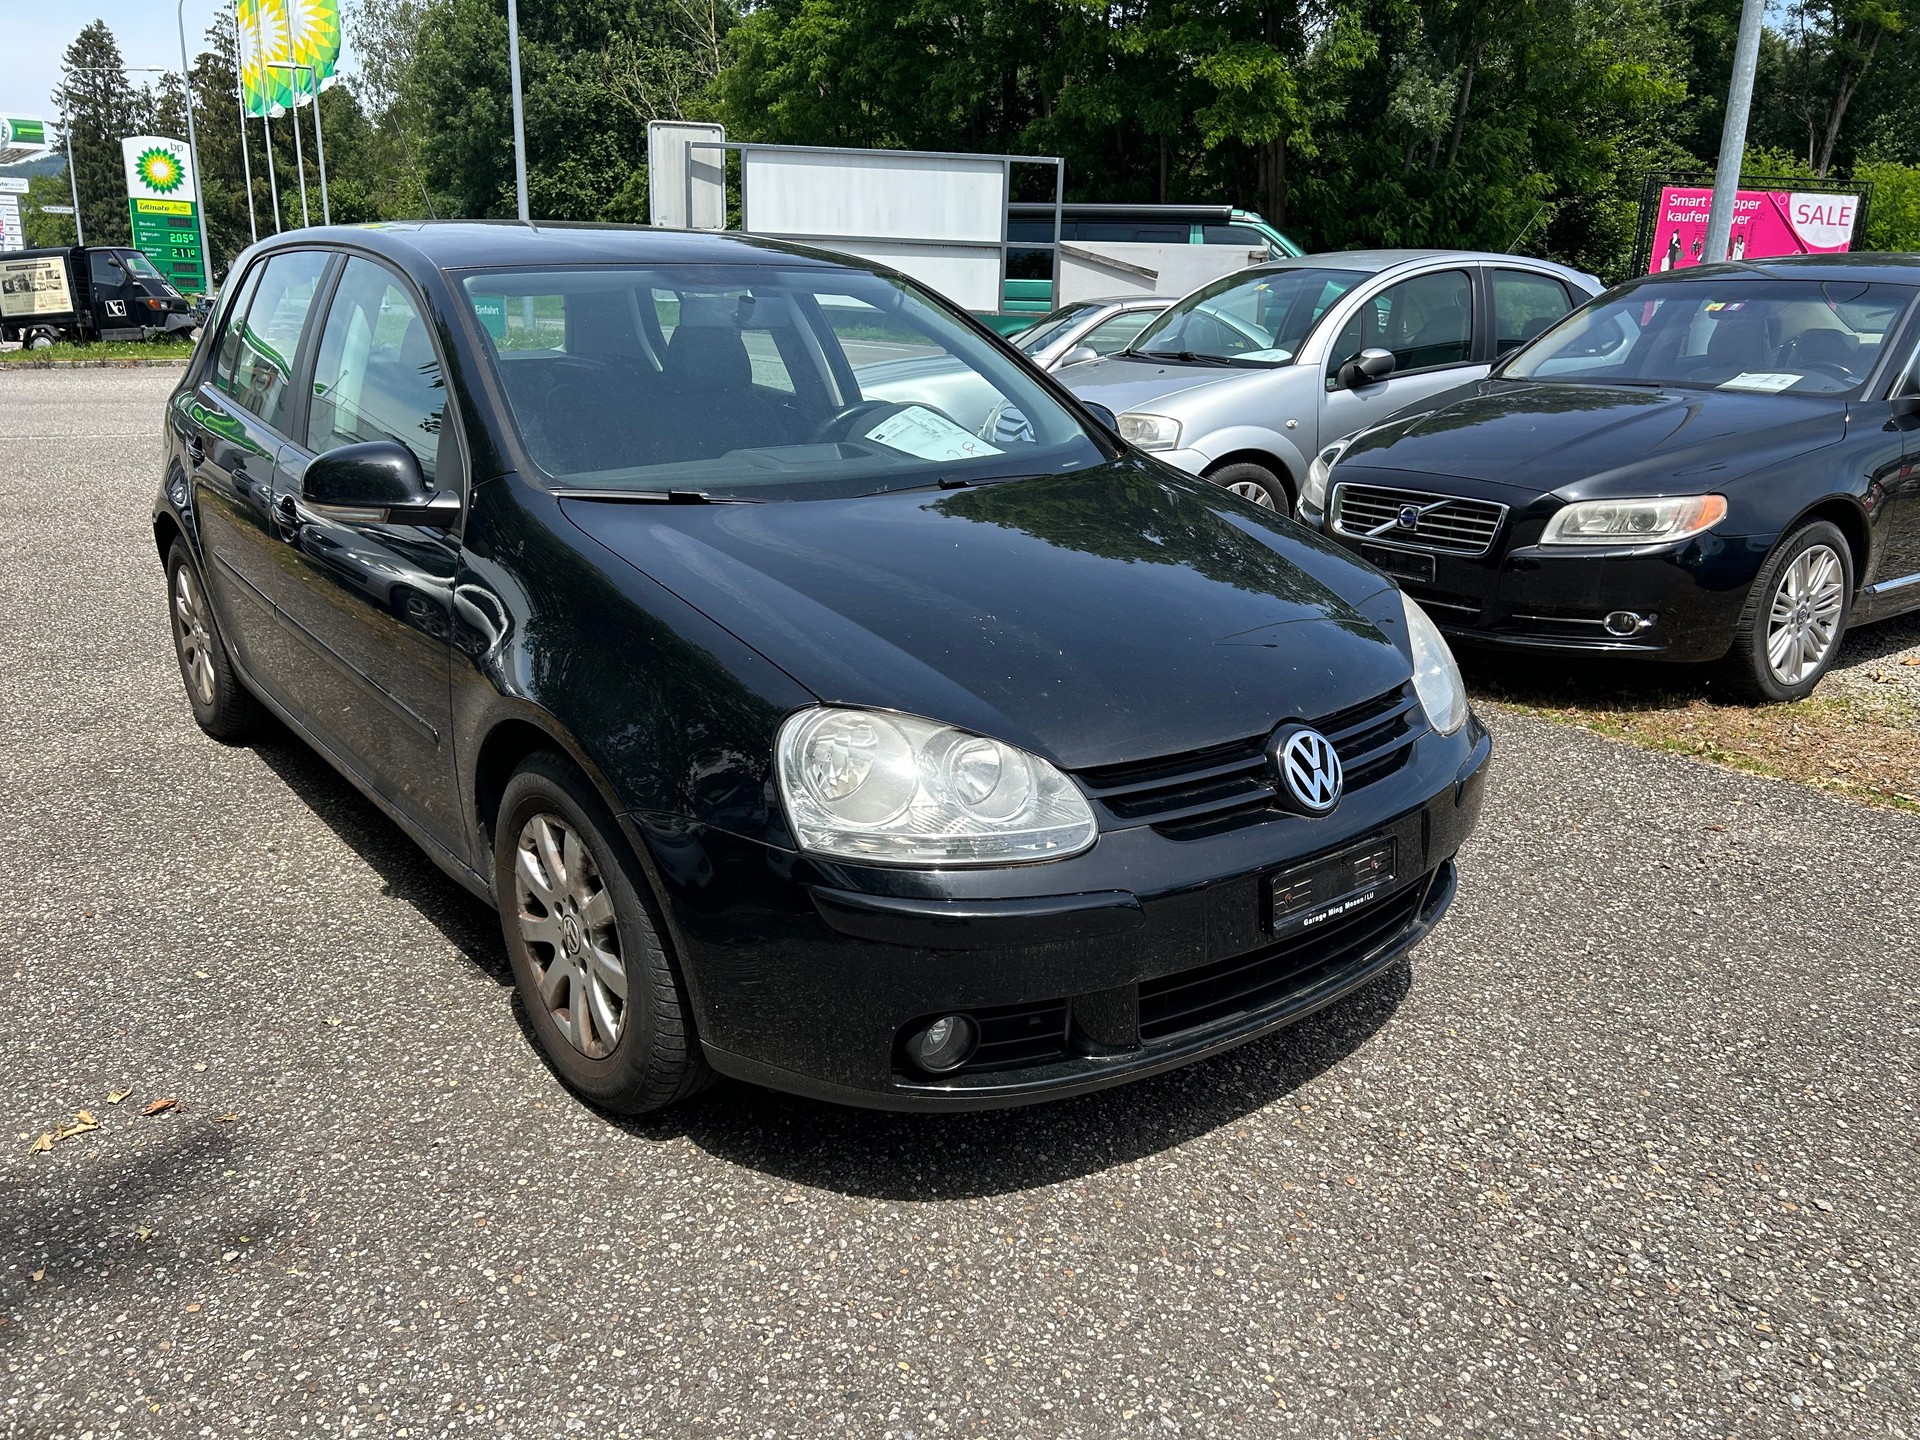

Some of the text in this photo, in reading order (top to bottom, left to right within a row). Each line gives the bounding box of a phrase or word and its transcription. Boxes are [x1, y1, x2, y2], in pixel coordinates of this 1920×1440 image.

[170, 142, 184, 153] bp
[1669, 193, 1706, 207] Smart
[1666, 210, 1709, 223] kaufen
[1796, 204, 1852, 227] SALE
[474, 305, 499, 315] Einfahrt
[1303, 912, 1327, 926] Garage
